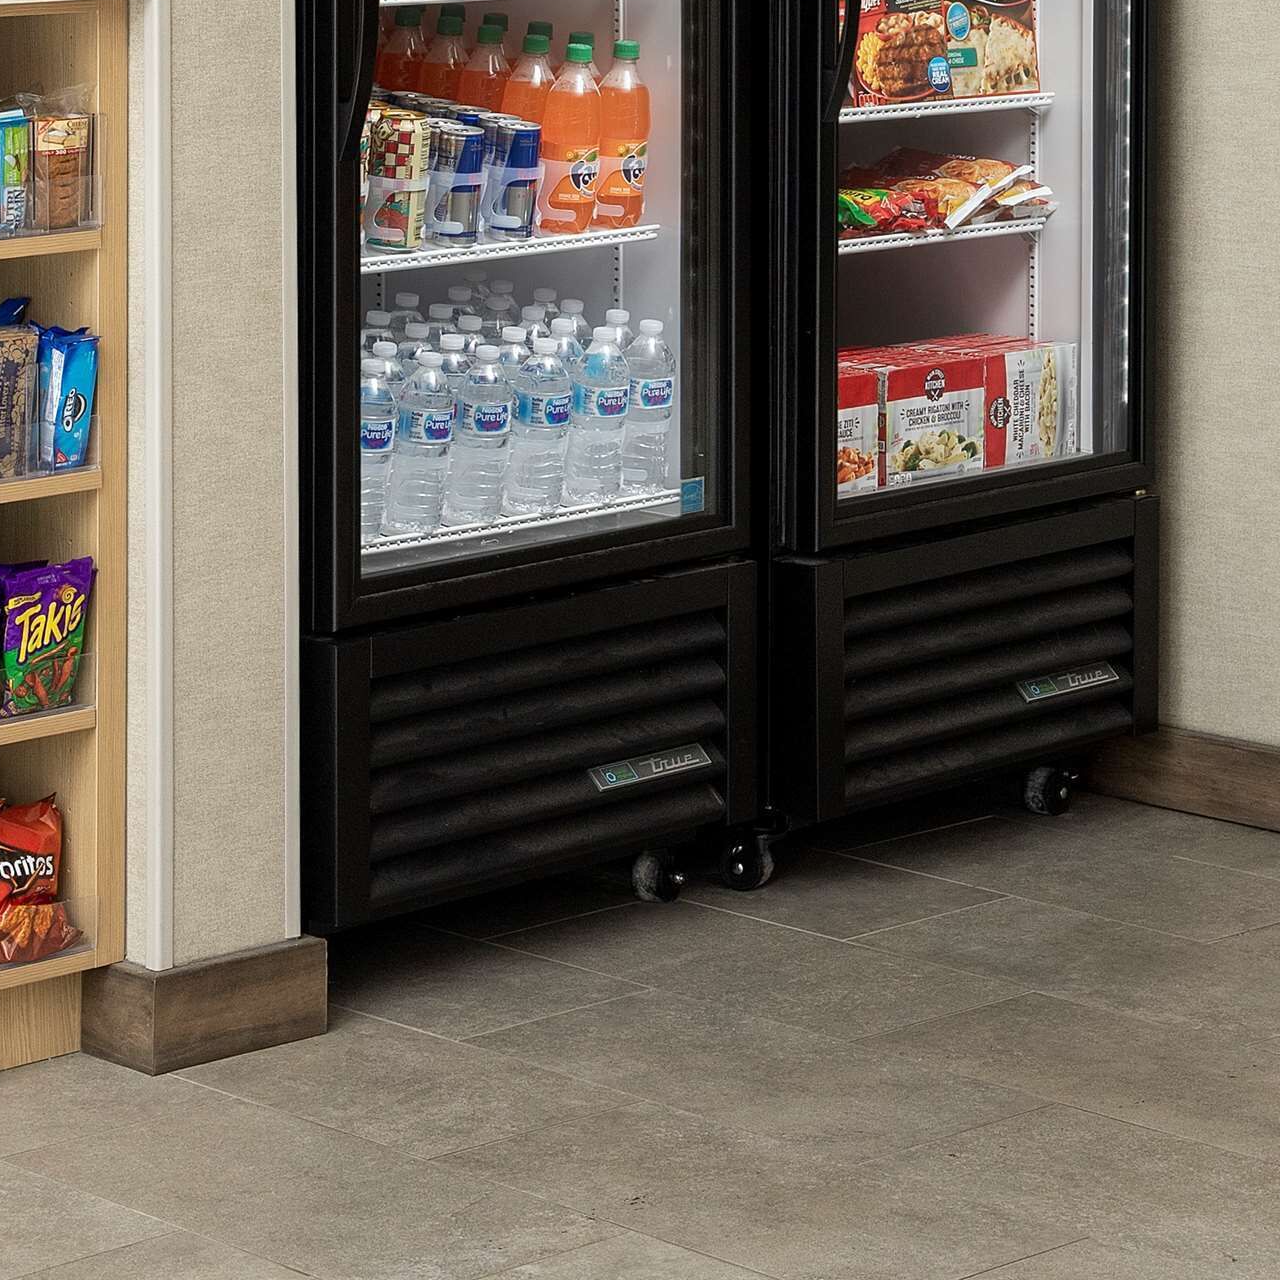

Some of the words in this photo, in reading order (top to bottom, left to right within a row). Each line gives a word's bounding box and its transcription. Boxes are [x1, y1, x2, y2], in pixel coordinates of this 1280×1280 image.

[0, 380, 9, 410] Lovers
[642, 389, 661, 397] Pure
[598, 398, 617, 406] Pure
[62, 387, 77, 432] OREO
[546, 406, 565, 414] Pure
[906, 406, 927, 418] CREAMY
[927, 404, 950, 416] RIGATONI
[950, 402, 964, 412] WITH
[475, 412, 496, 422] Pure
[495, 411, 509, 424] Life
[908, 414, 930, 425] CHICKEN
[936, 410, 962, 422] BROCCOLI
[425, 420, 445, 430] Pure
[361, 429, 382, 439] Pure
[15, 593, 86, 664] Takis
